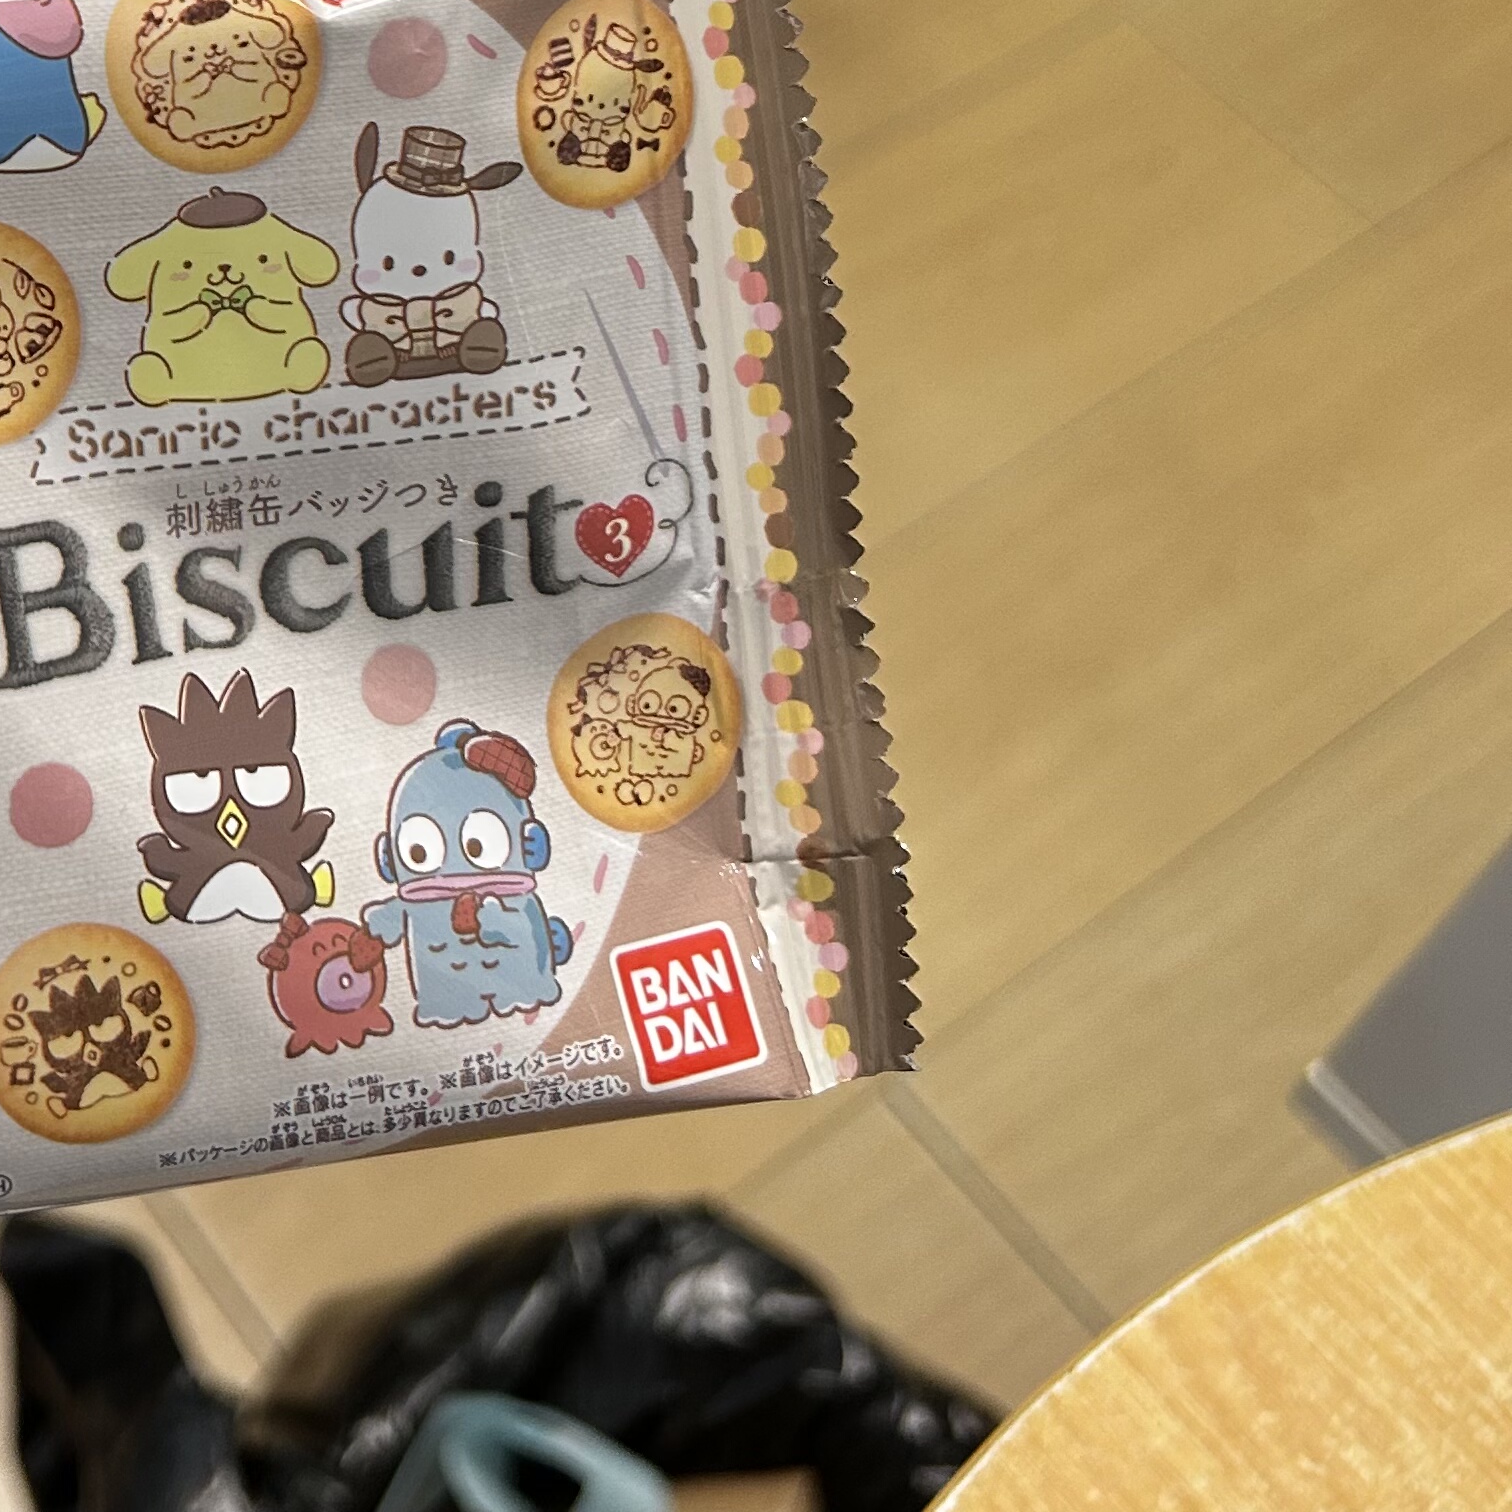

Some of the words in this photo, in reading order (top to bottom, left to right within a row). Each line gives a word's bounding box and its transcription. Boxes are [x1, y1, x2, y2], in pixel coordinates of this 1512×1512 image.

[68, 406, 243, 463] Sanrio
[263, 378, 557, 444] characters
[165, 473, 459, 538] 刺繍缶バッジつき
[603, 517, 631, 561] 3
